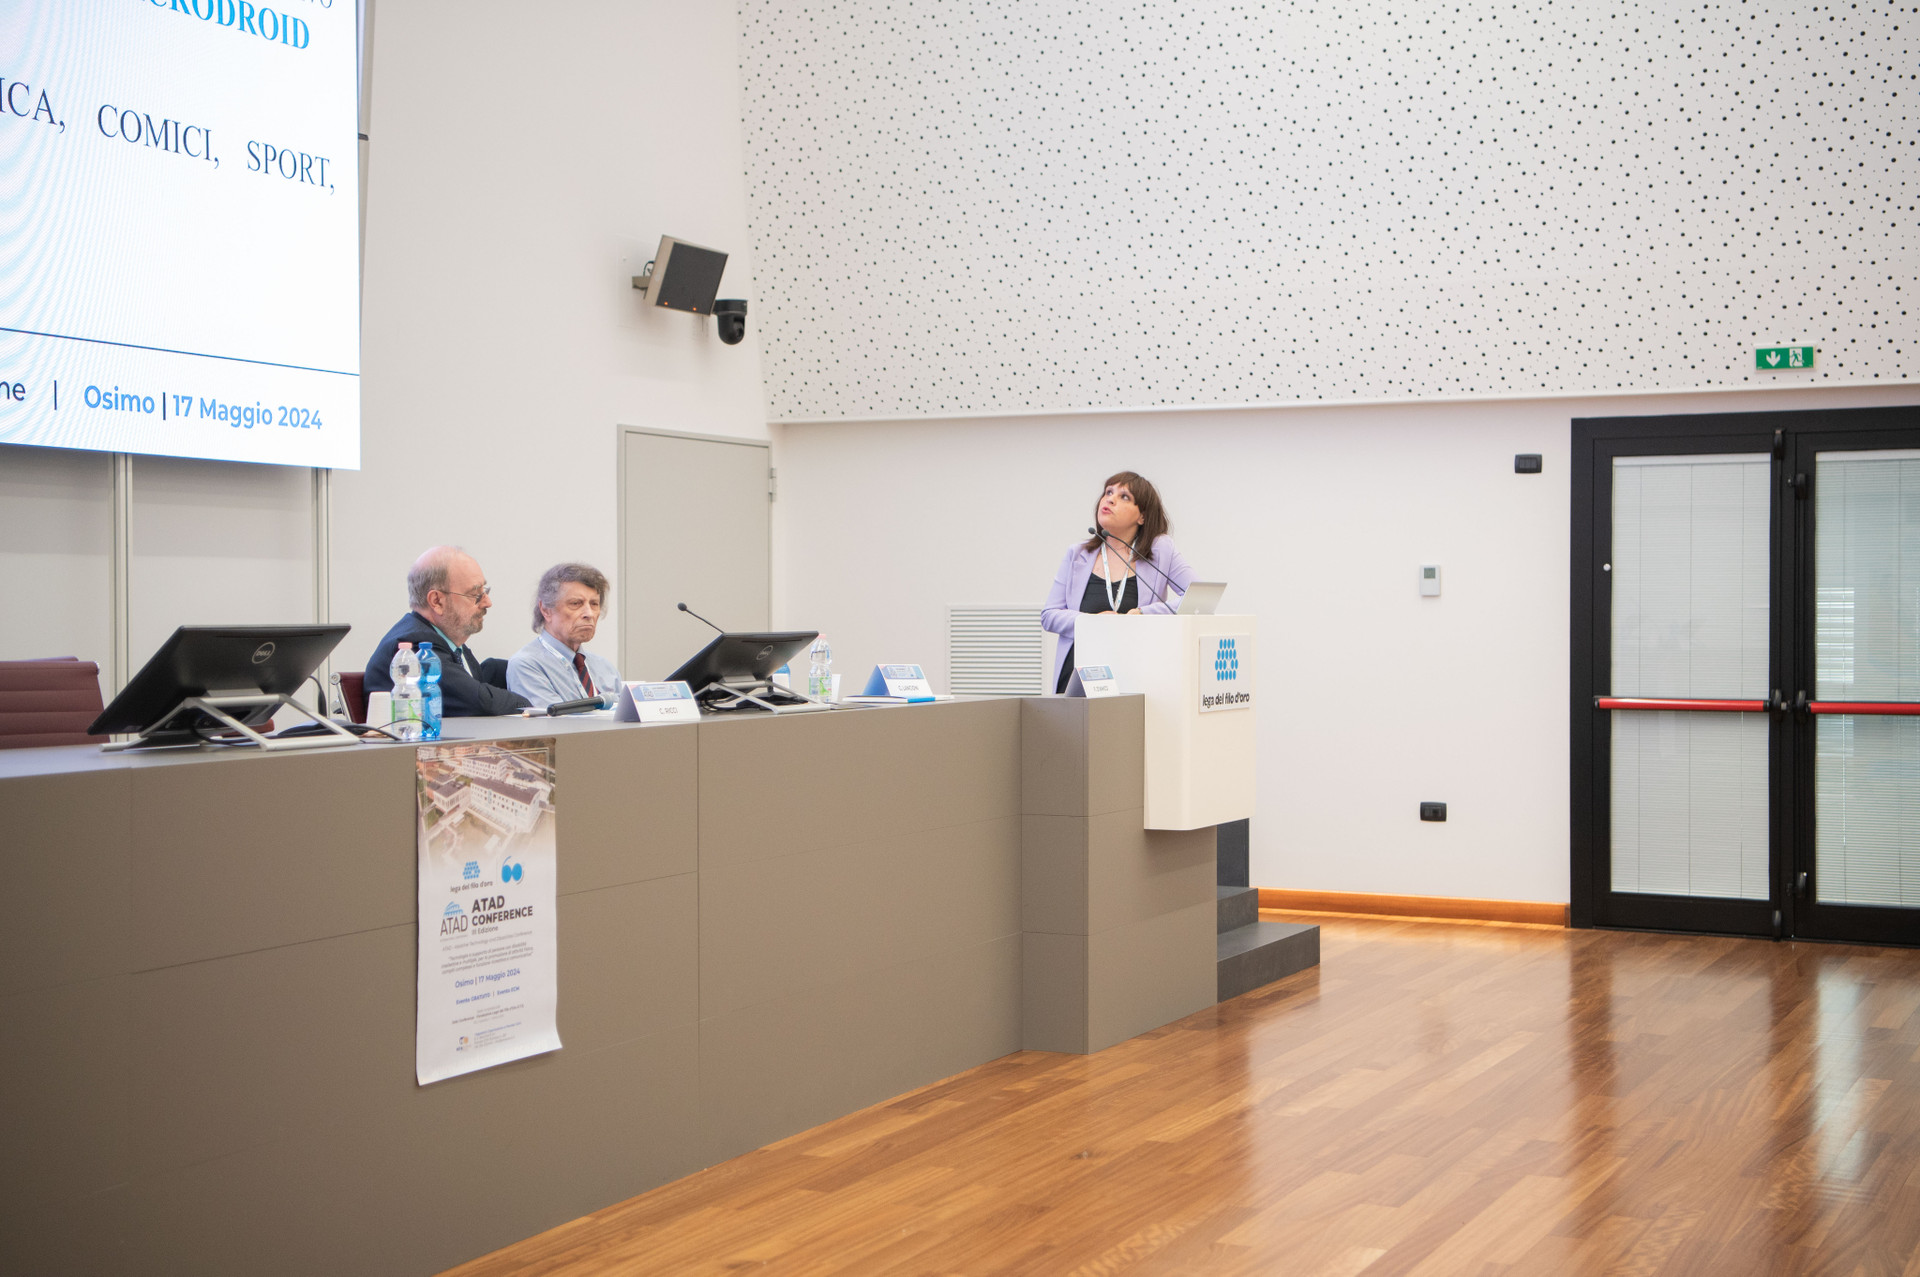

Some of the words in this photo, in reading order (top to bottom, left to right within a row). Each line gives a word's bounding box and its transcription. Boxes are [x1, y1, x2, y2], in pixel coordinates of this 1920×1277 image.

[97, 104, 220, 169] COMICI,
[246, 140, 335, 195] SPORT,
[84, 385, 155, 414] Osimo
[172, 394, 193, 417] 17
[199, 397, 273, 430] Maggio
[278, 406, 323, 430] 2024
[1202, 694, 1214, 708] lega
[1215, 693, 1224, 705] del
[1235, 691, 1250, 703] d'oro
[471, 895, 505, 914] ATAD
[440, 914, 468, 936] ATAD
[471, 905, 533, 926] CONFERENCE
[478, 926, 498, 935] Edizione
[455, 978, 474, 988] Osimo
[478, 975, 485, 983] 17
[485, 971, 506, 981] Maggio
[506, 968, 521, 977] 2024
